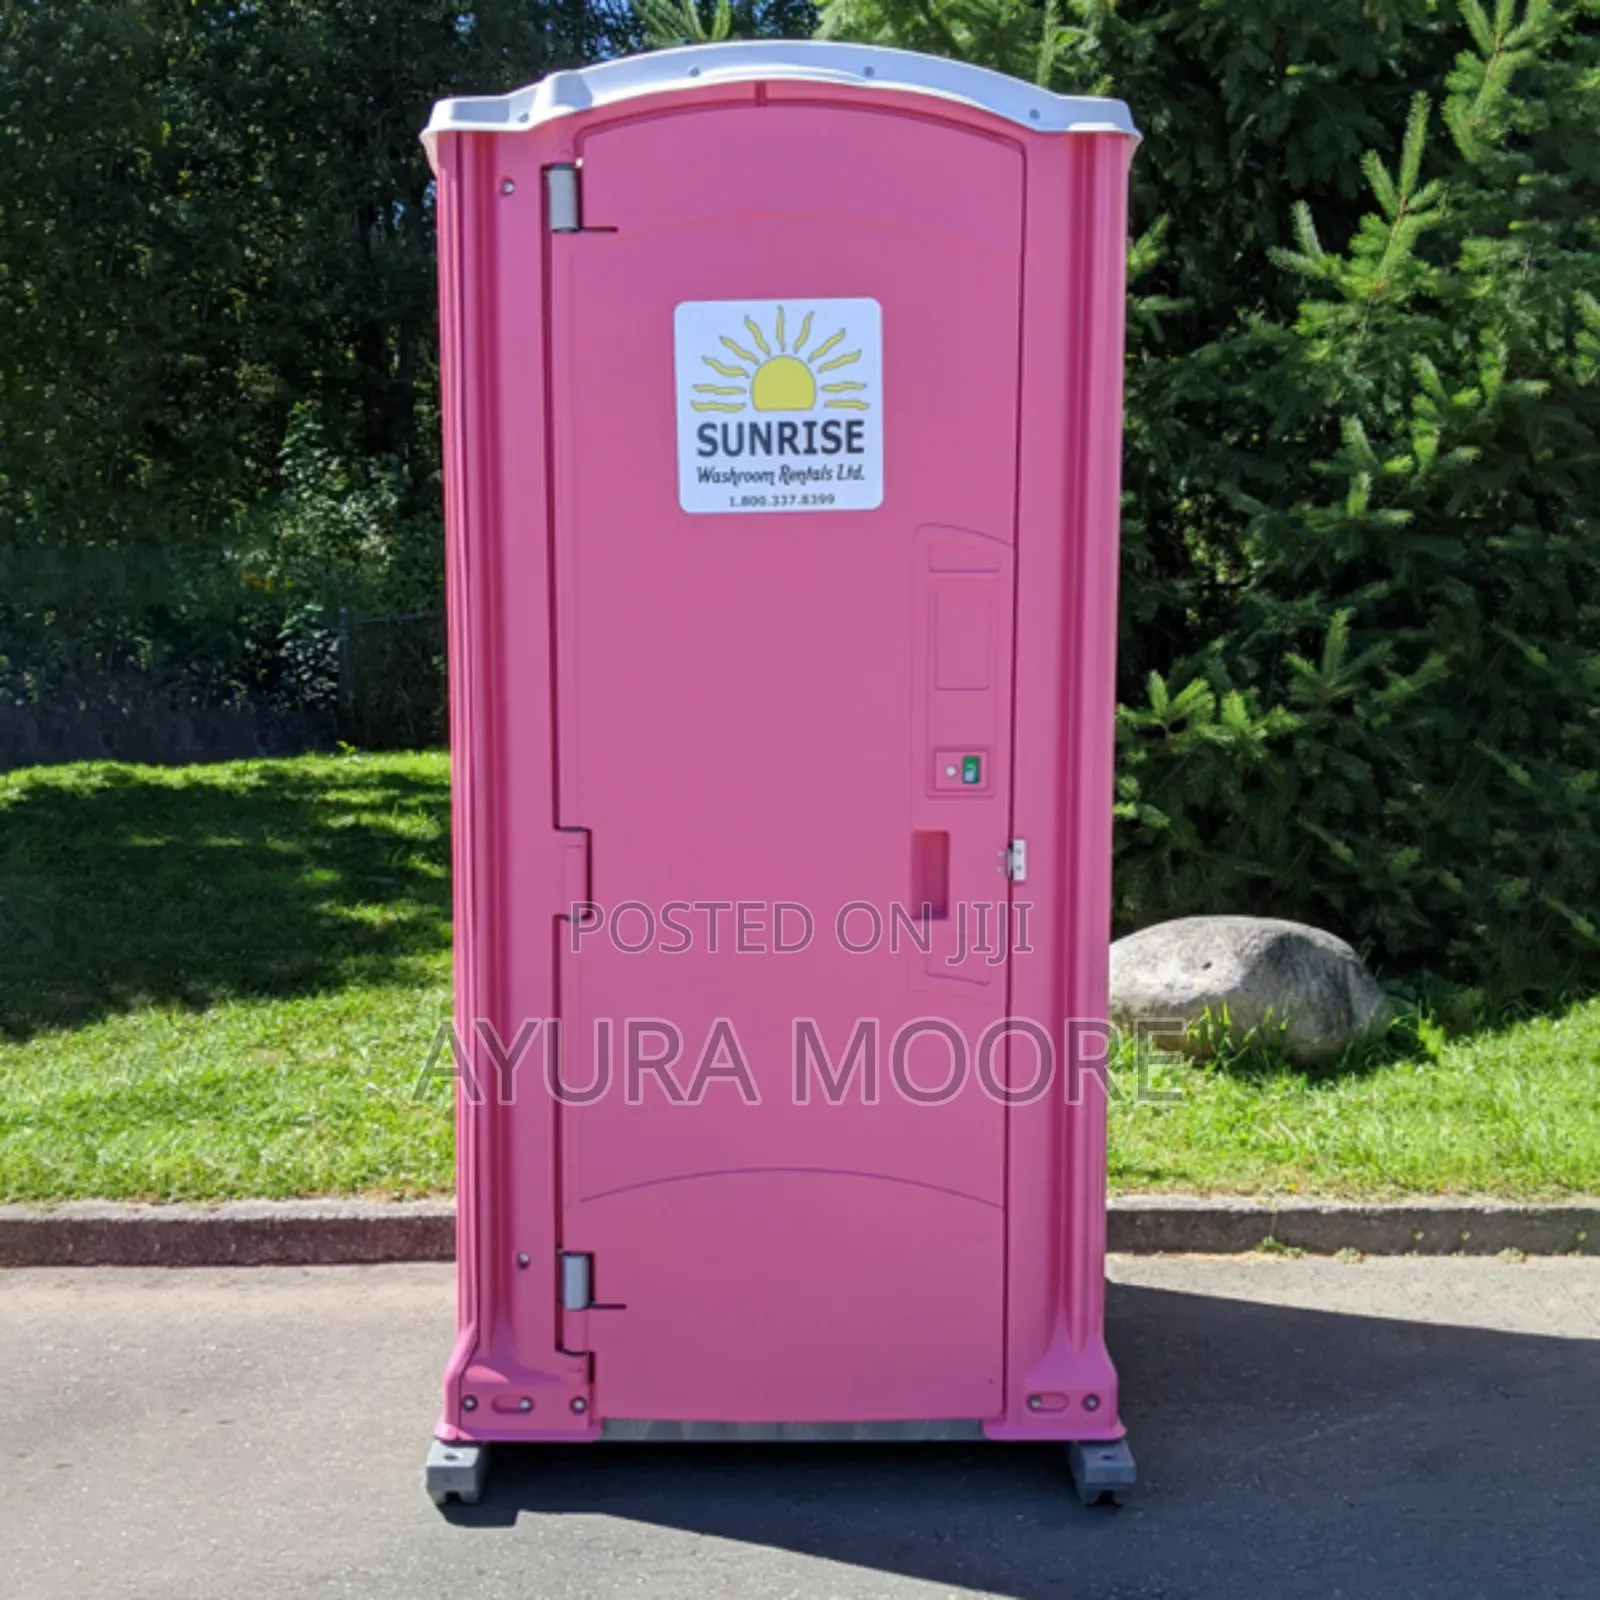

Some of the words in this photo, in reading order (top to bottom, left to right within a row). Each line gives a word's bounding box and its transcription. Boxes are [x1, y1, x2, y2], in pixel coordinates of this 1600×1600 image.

[696, 419, 865, 458] SUNRISE
[696, 465, 775, 487] Washroom
[778, 464, 833, 486] Rentals
[837, 463, 865, 481] Ltd.
